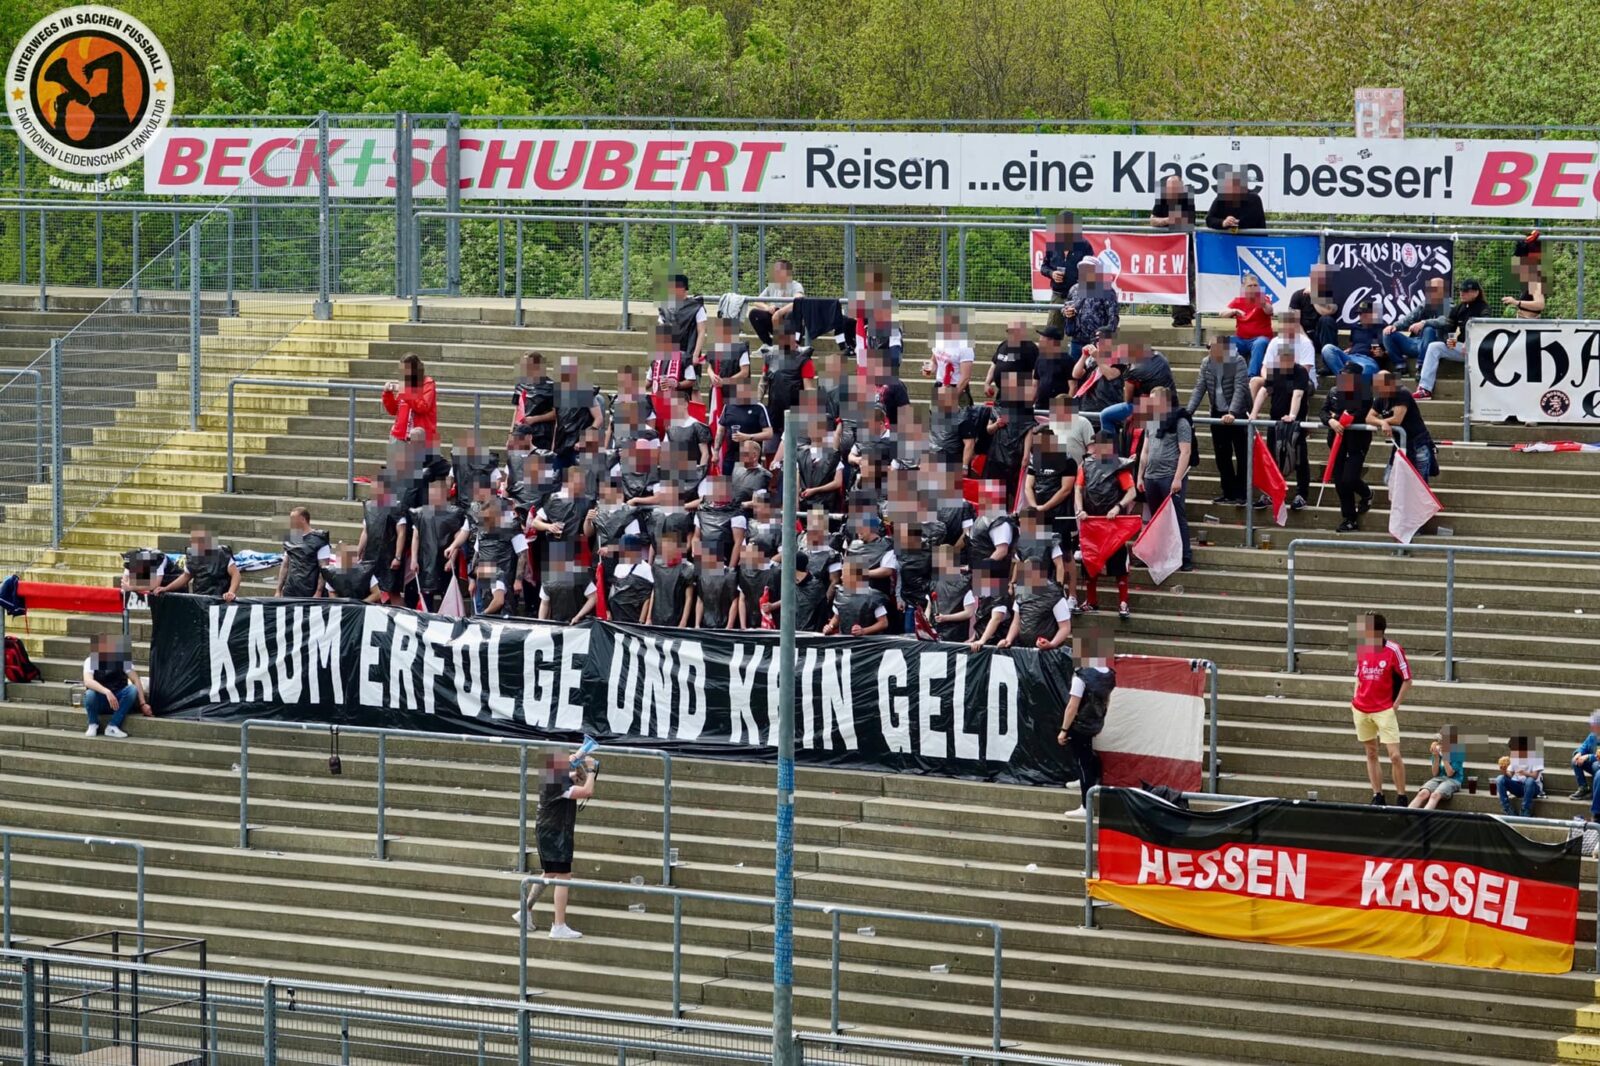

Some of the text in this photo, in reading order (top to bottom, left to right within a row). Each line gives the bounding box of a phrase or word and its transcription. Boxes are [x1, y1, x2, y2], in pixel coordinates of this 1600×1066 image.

[806, 147, 949, 190] Reisen
[1283, 153, 1453, 199] besser!
[1471, 151, 1600, 208] BE
[1130, 253, 1185, 275] CREW
[208, 604, 345, 705] KAUM
[359, 605, 591, 731] ERFOLGE
[606, 632, 707, 741] UND
[877, 648, 1020, 762] GELD
[1138, 844, 1530, 931] HESSEN KASSEL
